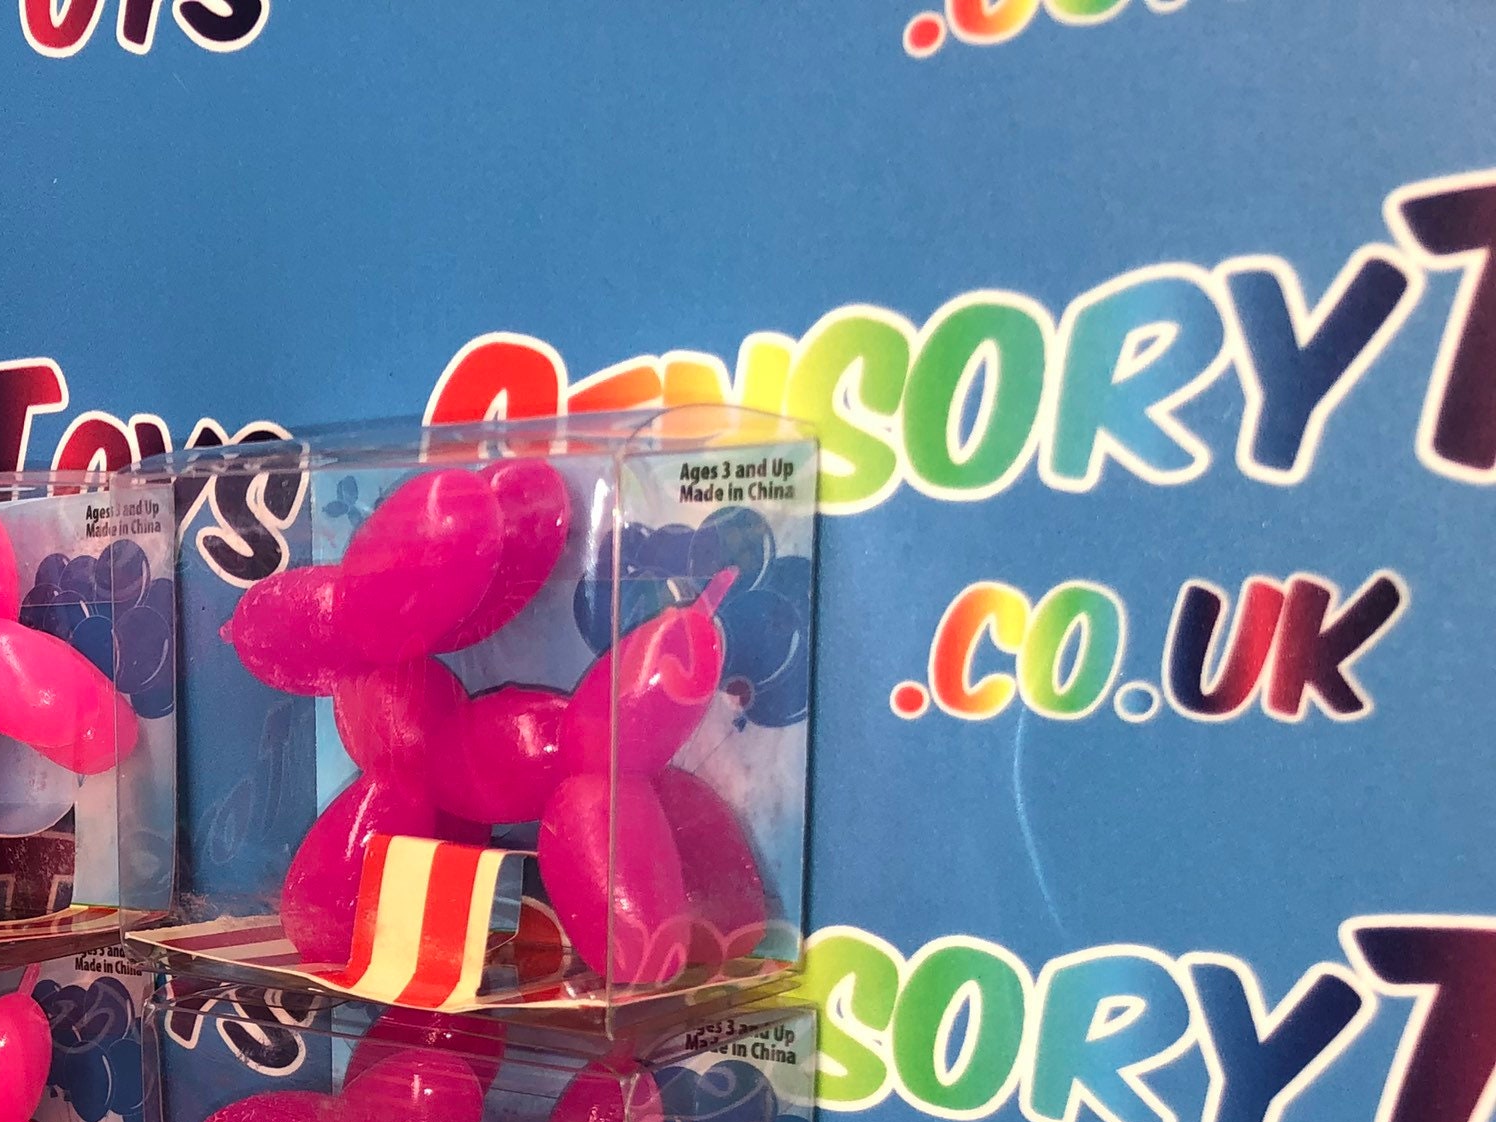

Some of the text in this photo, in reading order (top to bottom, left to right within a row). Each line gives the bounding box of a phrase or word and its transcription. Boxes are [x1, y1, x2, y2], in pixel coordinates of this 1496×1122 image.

[680, 458, 794, 486] Ages 3 and Up
[680, 481, 795, 503] Made in China
[85, 505, 113, 523] Ages
[122, 500, 142, 516] and
[145, 499, 159, 518] Up
[85, 519, 161, 538] Made in China
[890, 567, 1410, 724] .CO.UK
[75, 957, 101, 973] Made
[104, 959, 113, 974] in
[774, 1025, 794, 1046] Up
[732, 1043, 747, 1058] in
[751, 1042, 796, 1065] China
